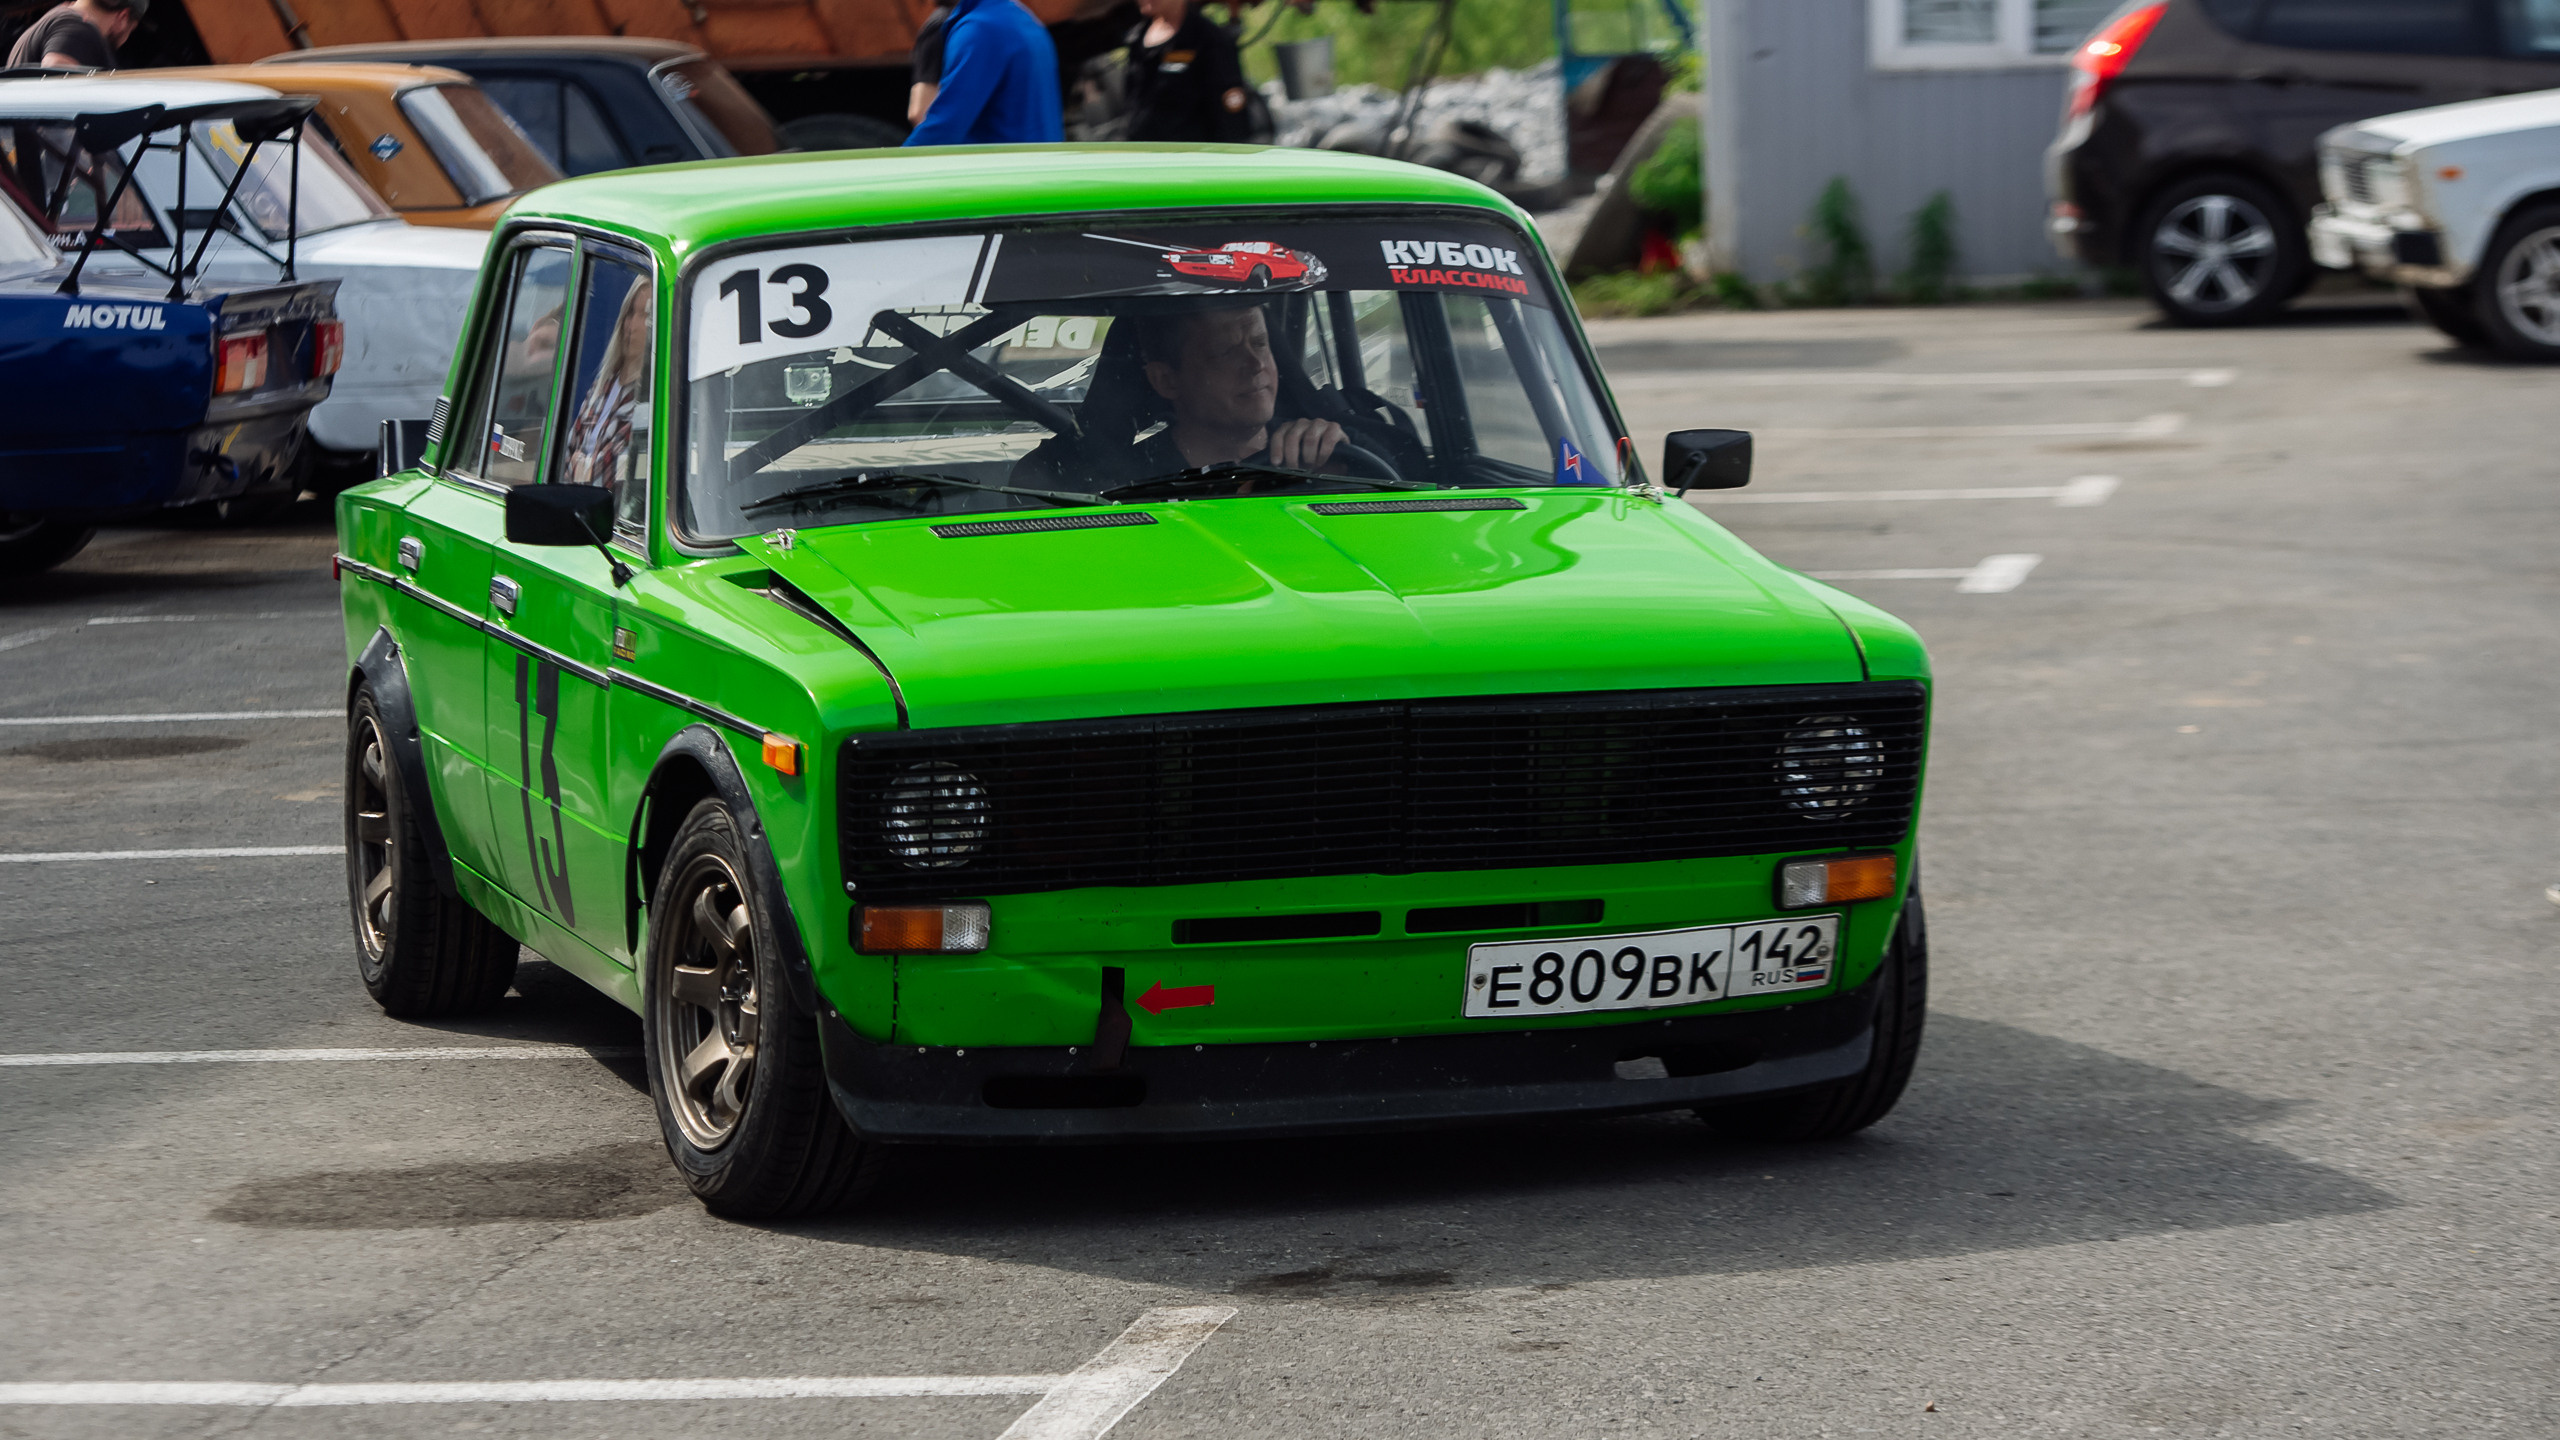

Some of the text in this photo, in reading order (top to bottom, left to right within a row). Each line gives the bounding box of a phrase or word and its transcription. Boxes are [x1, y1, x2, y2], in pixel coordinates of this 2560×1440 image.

[1380, 240, 1523, 275] КУБОК
[1391, 269, 1528, 295] КЛАССИКИ
[63, 304, 166, 331] MOTUL
[720, 263, 832, 345] 13
[515, 653, 575, 928] 13
[1488, 925, 1821, 1008] Е809ВК 142
[1752, 968, 1795, 986] RUS
